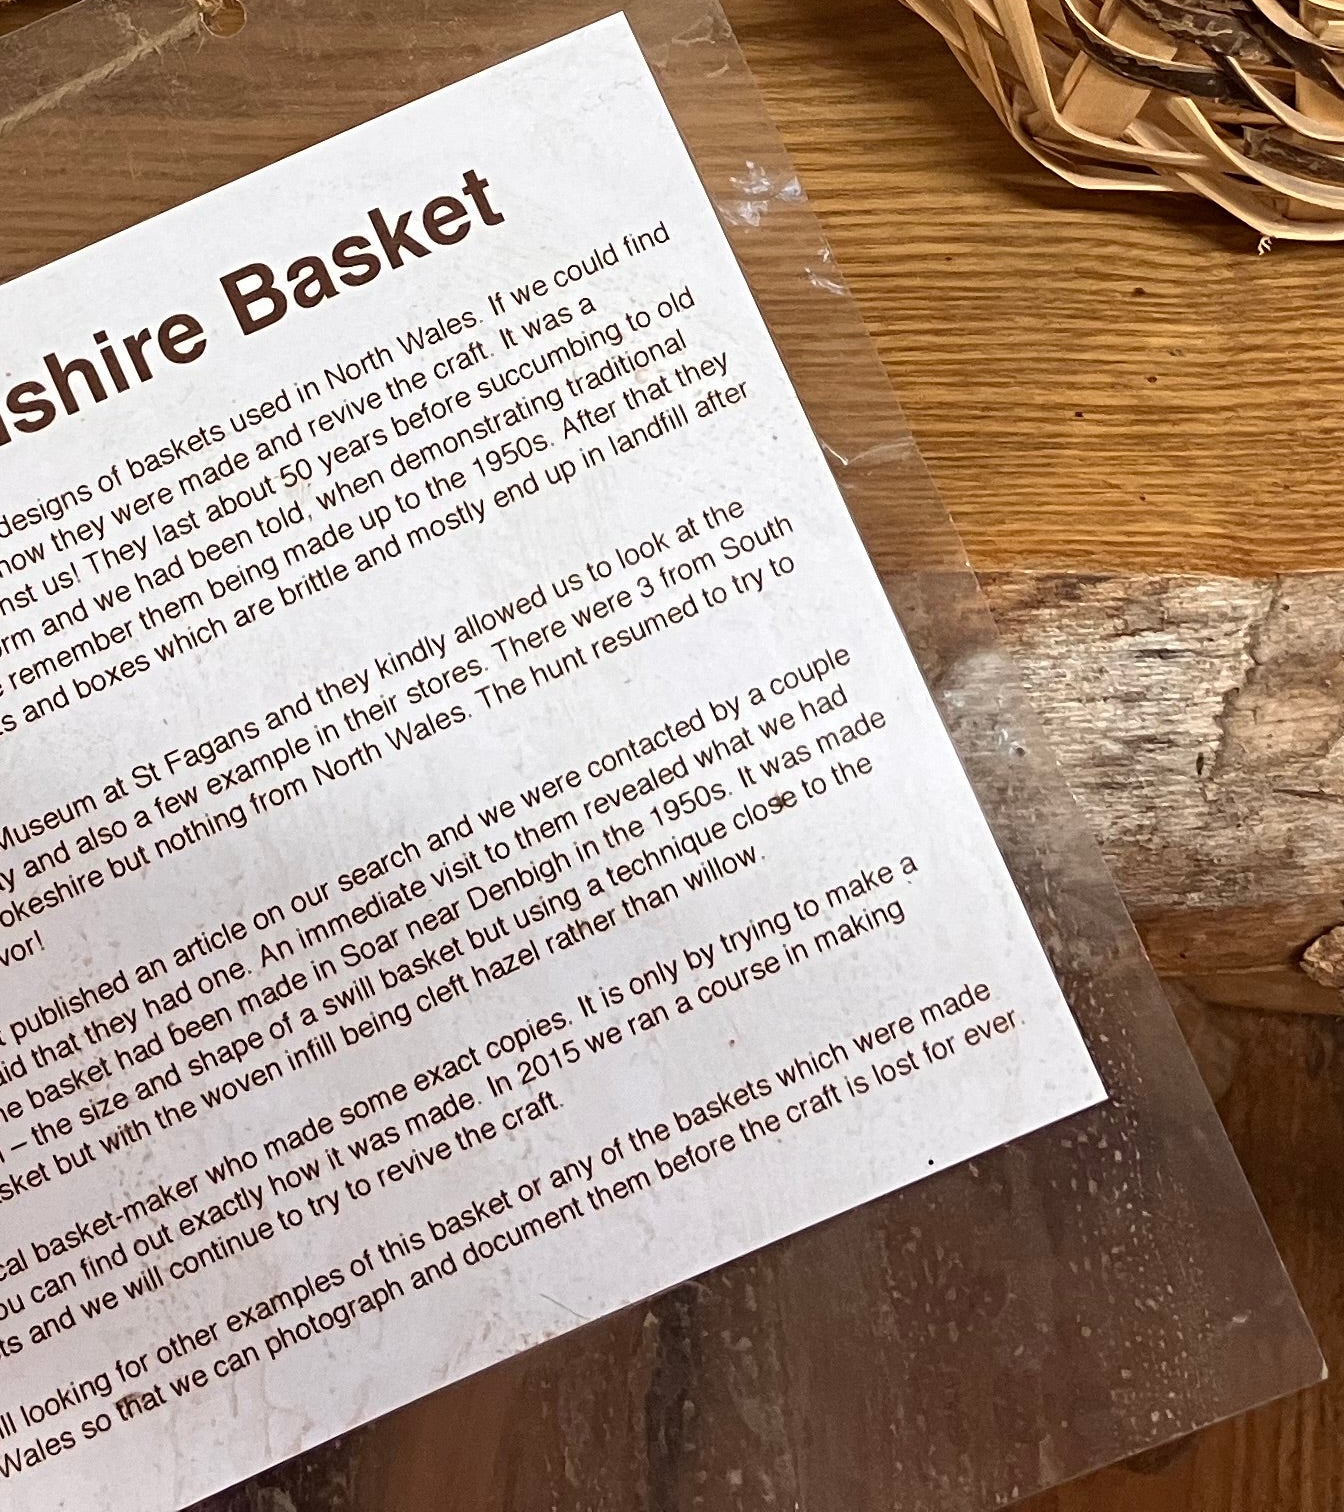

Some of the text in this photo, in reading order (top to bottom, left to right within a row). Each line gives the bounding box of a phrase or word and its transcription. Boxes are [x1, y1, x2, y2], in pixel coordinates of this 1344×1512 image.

[96, 463, 124, 494] of
[124, 423, 227, 481] baskets
[228, 387, 293, 434] used
[292, 380, 322, 405] in
[322, 345, 396, 391] North
[394, 310, 485, 356] Wales.
[486, 290, 507, 318] If
[508, 278, 550, 307] we
[552, 241, 621, 289] could
[622, 219, 672, 258] find
[217, 167, 507, 337] Basket
[40, 560, 83, 597] us!
[80, 534, 148, 576] They
[151, 508, 202, 547] last
[204, 474, 278, 524] about
[278, 457, 314, 489] 50
[316, 427, 390, 478] years
[389, 389, 473, 439] before
[475, 321, 625, 400] succumbing
[624, 309, 653, 333] to
[656, 284, 697, 320] old
[101, 775, 131, 805] at
[130, 761, 163, 790] St
[162, 720, 261, 777] Fagans
[264, 690, 314, 732] and
[314, 667, 370, 707] they
[373, 632, 447, 681] kindly
[453, 582, 549, 645] allowed
[550, 572, 585, 600] us
[585, 559, 614, 583] to
[613, 530, 672, 571] look
[674, 515, 701, 544] at
[701, 500, 746, 531] the
[8, 968, 131, 1047] published
[133, 957, 170, 986] an
[171, 921, 249, 969] article
[252, 904, 287, 932] on
[289, 880, 330, 915] our
[336, 840, 423, 894] search
[425, 812, 475, 853] and
[476, 799, 517, 829] we
[518, 769, 583, 809] were
[586, 706, 707, 779] contacted
[707, 694, 741, 724] by
[746, 686, 768, 707] a
[768, 647, 852, 697] couple
[24, 1055, 114, 1111] basket
[112, 1030, 166, 1072] had
[165, 1005, 234, 1048] been
[235, 971, 310, 1018] made
[308, 958, 339, 984] in
[339, 926, 400, 969] Soar
[404, 899, 462, 941] near
[465, 849, 573, 912] Denbigh
[571, 839, 602, 864] in
[601, 819, 646, 850] the
[648, 781, 734, 828] 1950s.
[735, 764, 759, 790] It
[758, 743, 813, 779] was
[814, 710, 887, 755] made
[51, 1140, 98, 1177] but
[97, 1118, 153, 1156] with
[152, 1099, 199, 1131] the
[198, 1060, 285, 1110] woven
[283, 1030, 338, 1073] infill
[337, 1000, 414, 1048] being
[415, 972, 471, 1014] cleft
[469, 937, 542, 988] hazel
[544, 906, 618, 956] rather
[620, 882, 680, 920] than
[681, 844, 767, 892] willow.
[18, 1370, 114, 1429] looking
[113, 1352, 150, 1384] for
[155, 1321, 220, 1366] other
[225, 1267, 347, 1334] examples
[348, 1247, 376, 1279] of
[376, 1231, 427, 1266] this
[425, 1188, 515, 1243] basket
[516, 1175, 543, 1204] or
[548, 1153, 594, 1190] any
[599, 1135, 626, 1167] of
[626, 1122, 672, 1154] the
[671, 1077, 774, 1134] baskets
[774, 1041, 851, 1088] which
[850, 1015, 916, 1055] were
[918, 982, 992, 1027] made
[29, 1173, 200, 1265] basket-maker
[203, 1150, 259, 1186] who
[261, 1115, 336, 1162] made
[338, 1082, 410, 1127] some
[412, 1045, 483, 1093] exact
[485, 1010, 574, 1062] copies.
[576, 993, 600, 1019] It
[597, 984, 626, 1010] is
[627, 958, 679, 997] only
[681, 942, 715, 972] by
[718, 910, 793, 955] trying
[792, 898, 821, 922] to
[823, 865, 895, 910] make
[898, 855, 920, 877] a
